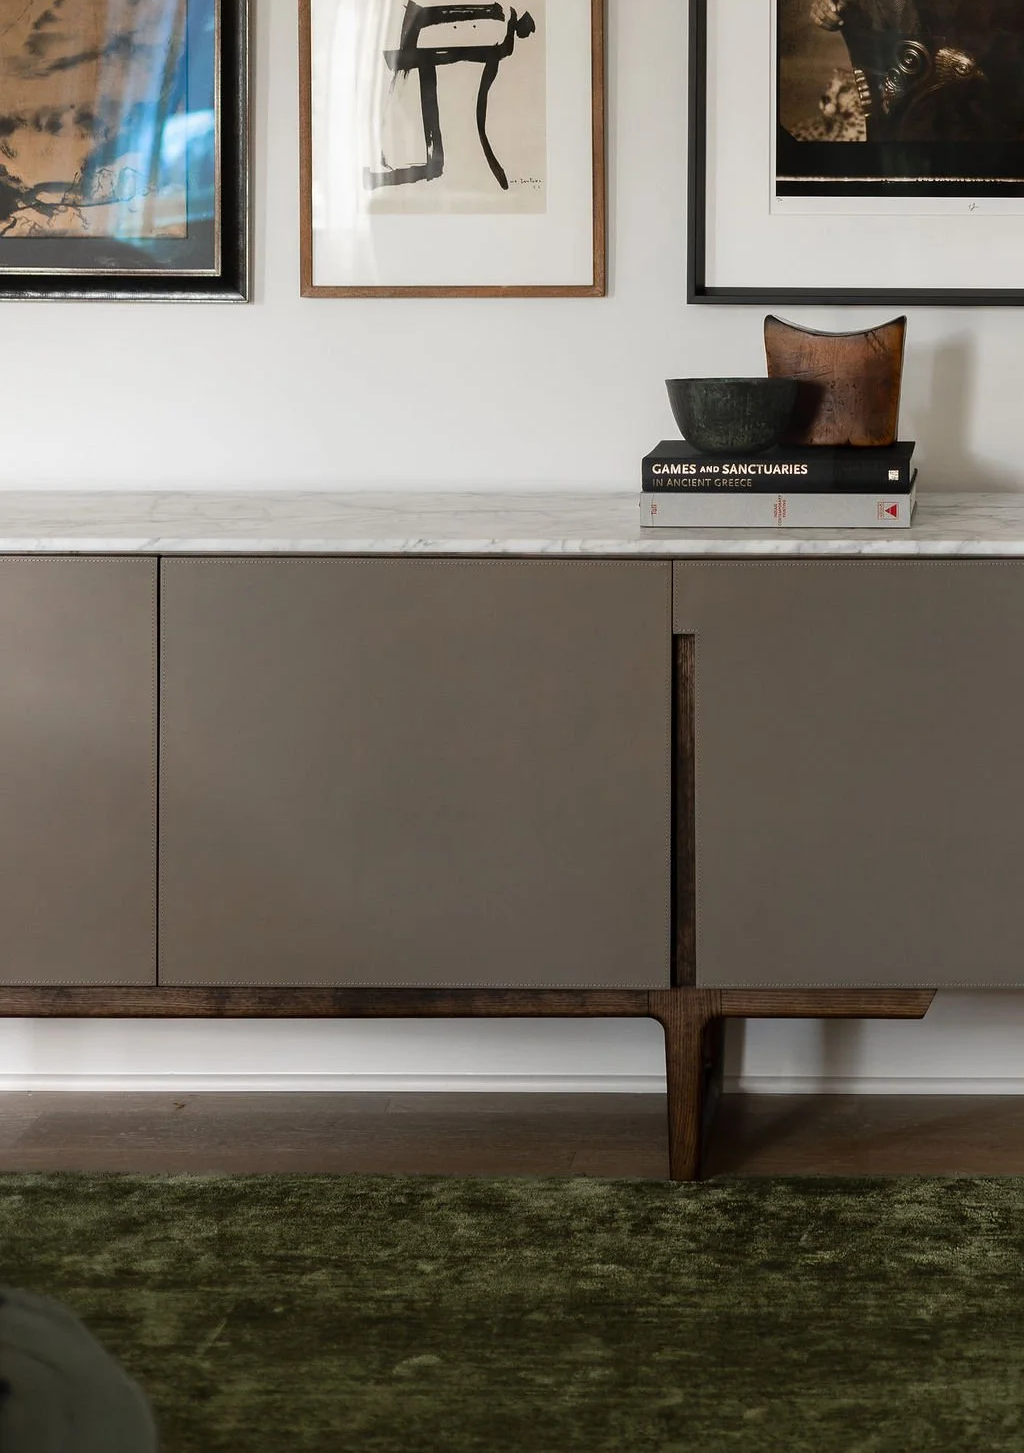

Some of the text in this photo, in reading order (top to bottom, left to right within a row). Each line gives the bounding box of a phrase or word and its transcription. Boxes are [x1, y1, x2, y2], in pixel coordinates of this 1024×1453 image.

[652, 464, 808, 475] GAMES AND SANCTUARIES
[652, 478, 752, 487] IN ANCIENT GREECE
